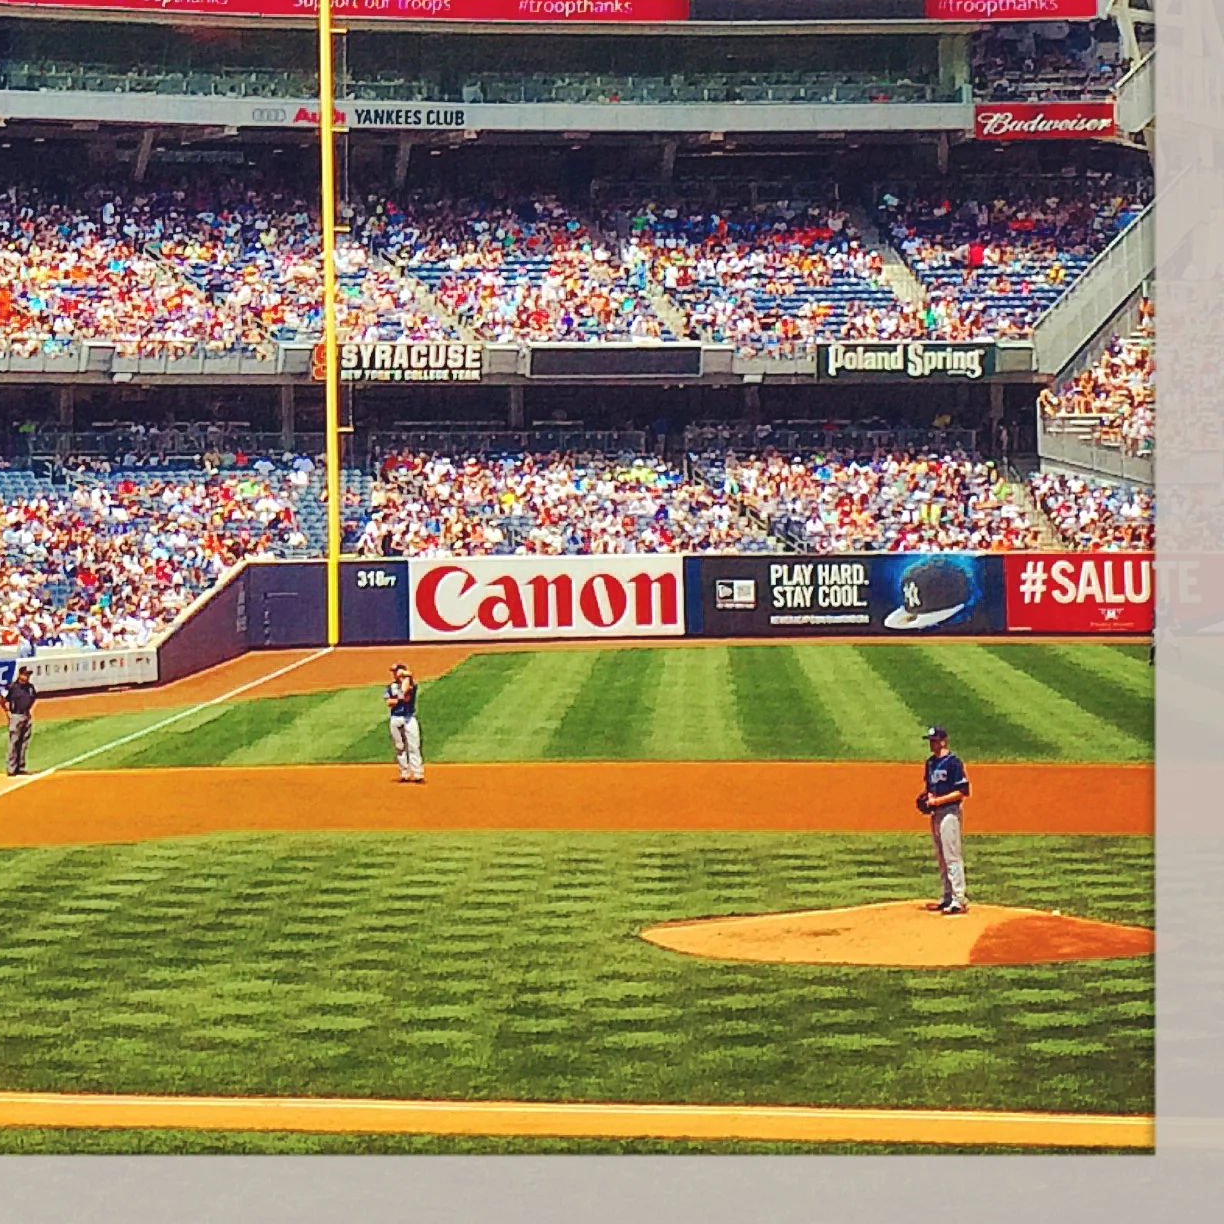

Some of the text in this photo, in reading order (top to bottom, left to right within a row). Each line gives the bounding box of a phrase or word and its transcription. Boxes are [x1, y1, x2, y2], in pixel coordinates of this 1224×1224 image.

[354, 108, 466, 127] YANKEES CLUB
[977, 112, 1113, 135] Budweiser
[340, 344, 482, 369] SYRACUSE
[828, 343, 985, 378] Poland Spring
[770, 563, 870, 585] PLAY HARD.
[415, 565, 679, 633] Canon
[772, 585, 814, 608] STAY
[818, 584, 868, 608] COOL.
